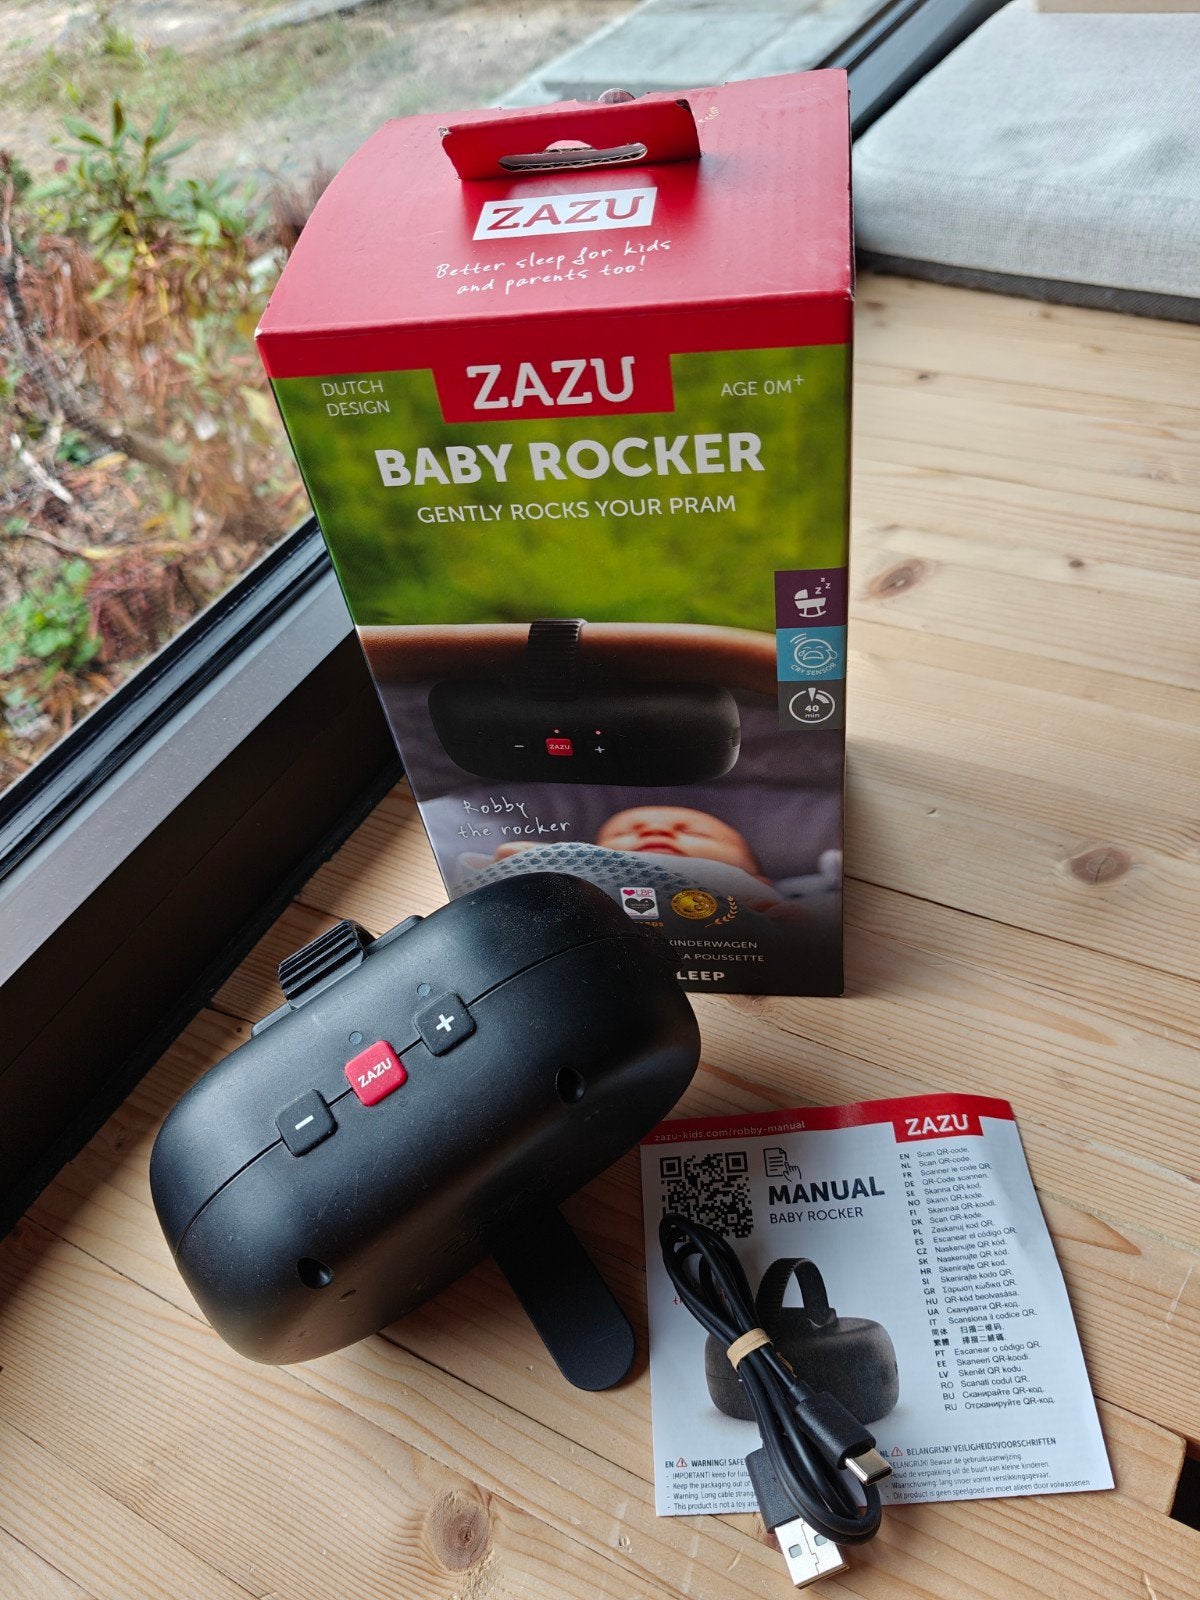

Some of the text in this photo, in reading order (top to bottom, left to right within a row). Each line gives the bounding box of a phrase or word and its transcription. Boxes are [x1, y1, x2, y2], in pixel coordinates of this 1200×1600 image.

[487, 195, 644, 231] ZAZU
[436, 240, 671, 279] Better sleep for kids
[456, 255, 646, 295] and parents too!
[322, 379, 384, 398] DUTCH
[466, 356, 636, 411] ZAZU
[720, 379, 759, 398] AGE
[326, 399, 391, 418] DESIGN
[375, 432, 765, 487] BABY ROCKER
[417, 494, 736, 524] GENTLY ROCKS YOUR PRAM
[790, 662, 837, 676] CRY SENSOR
[463, 796, 529, 819] Robby
[457, 817, 570, 839] the rocker
[694, 953, 765, 962] POUSSETTE
[357, 1057, 392, 1088] ZAZU
[904, 1113, 969, 1136] ZAZU
[654, 1120, 806, 1142] zazu-kids.com/robby-manual
[921, 1168, 949, 1176] Scanner
[922, 1176, 955, 1185] QR-Code
[768, 1176, 886, 1206] MANUAL
[924, 1187, 951, 1195] Skanna
[769, 1206, 864, 1225] BABY ROCKER
[928, 1206, 959, 1214] Skannaa
[931, 1225, 964, 1233] Zeskanuj
[933, 1234, 967, 1243] Escanear
[978, 1230, 1001, 1238] código
[935, 1243, 975, 1253] Naskenujte
[937, 1254, 977, 1263] Naskenujte
[939, 1264, 975, 1273] Skenirajte
[941, 1274, 977, 1283] Skenirajte
[979, 1271, 997, 1279] kodo
[944, 1294, 973, 1304] QR-kód
[946, 1305, 987, 1314] Сканувати
[948, 1315, 987, 1324] Scansiona
[954, 1346, 990, 1355] Escanear
[999, 1343, 1024, 1352] código
[956, 1357, 990, 1366] Skaneeri
[992, 1377, 1012, 1385] codul
[963, 1389, 1010, 1398] Сканирайте
[965, 1399, 1021, 1409] Отсканируйте
[907, 1447, 952, 1456] BELANGRIJK!
[953, 1437, 1056, 1453] VEILIGHEIDSVOORSCHRIFTEN
[691, 1459, 726, 1467] WARNING!
[930, 1458, 952, 1466] Bewaar
[918, 1469, 951, 1477] verpakking
[970, 1465, 988, 1473] buurt
[701, 1481, 731, 1489] packaging
[973, 1475, 991, 1483] vormt
[904, 1492, 928, 1500] product
[953, 1486, 985, 1497] speelgoed
[1050, 1480, 1090, 1488] volwassenen
[688, 1502, 711, 1510] product
